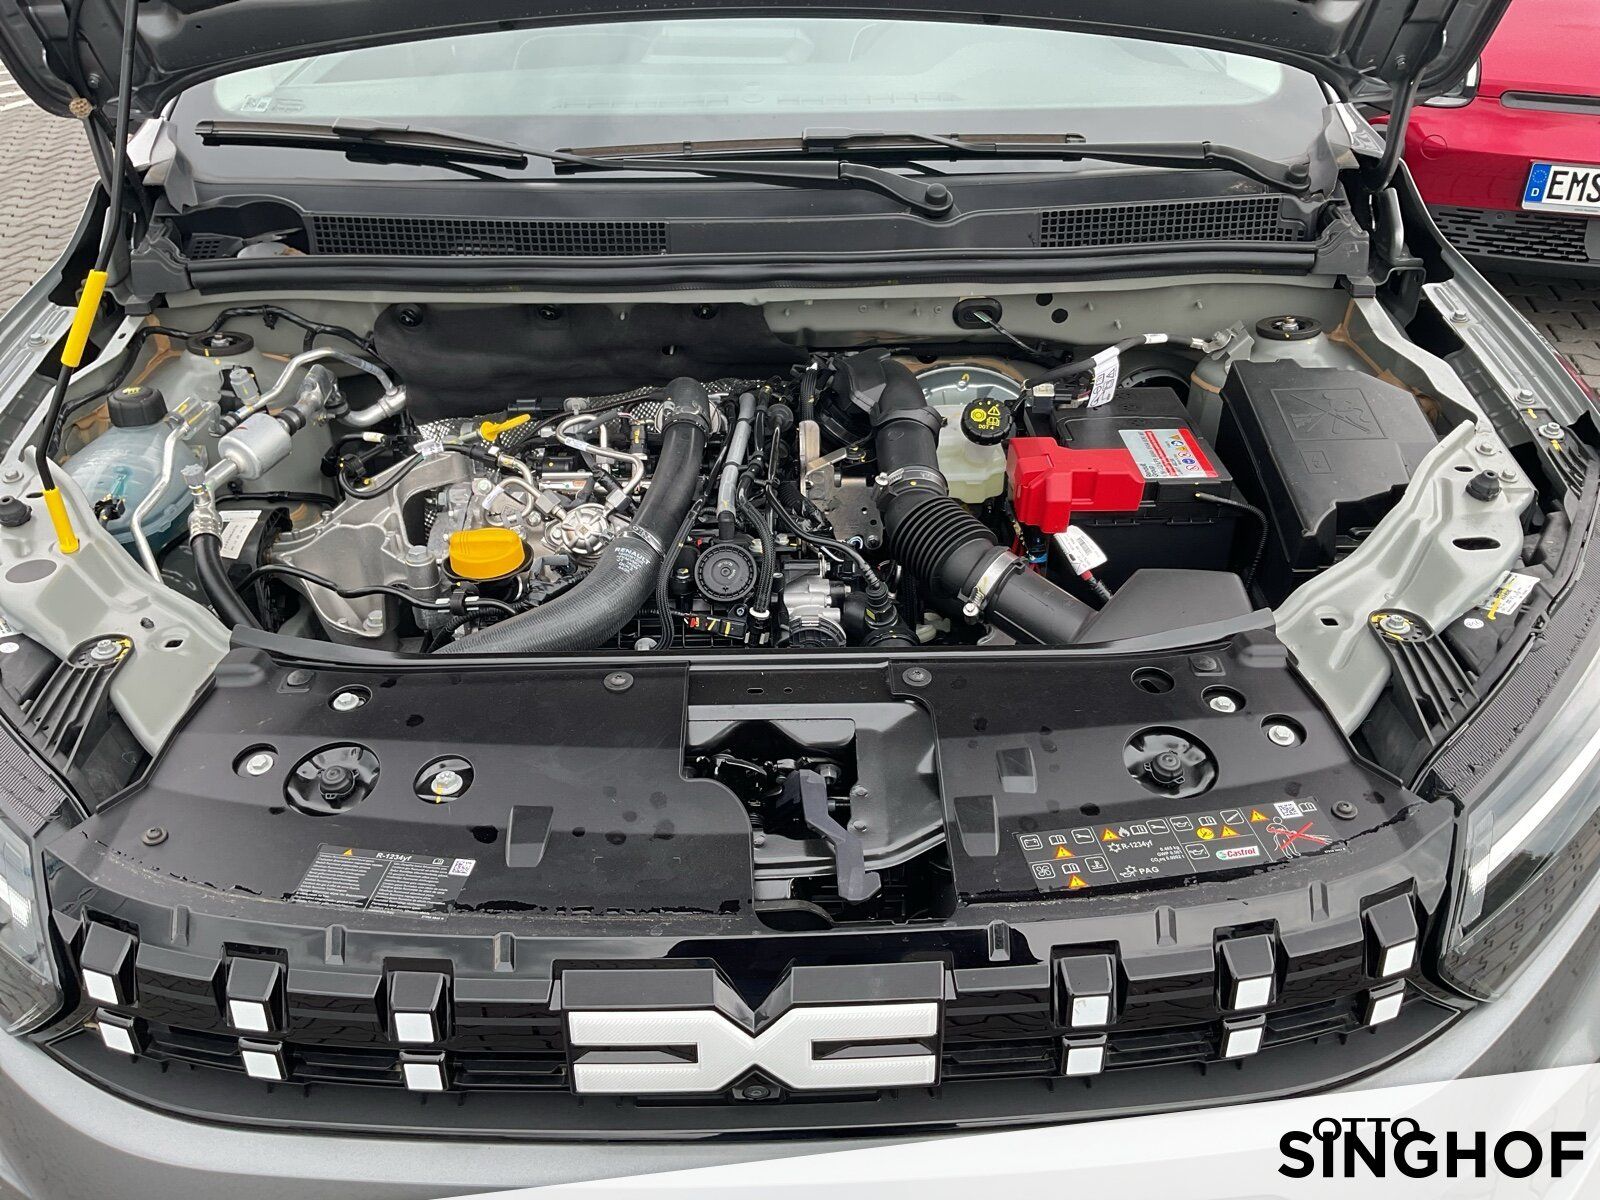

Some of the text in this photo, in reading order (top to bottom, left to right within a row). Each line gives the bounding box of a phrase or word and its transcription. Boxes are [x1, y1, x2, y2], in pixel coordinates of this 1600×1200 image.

[1531, 188, 1540, 197] D
[614, 547, 651, 565] RENAULT
[1121, 840, 1153, 850] R-1234yf
[376, 852, 412, 862] R-1234yf
[1227, 848, 1256, 858] Castrol
[1138, 866, 1160, 875] PAG
